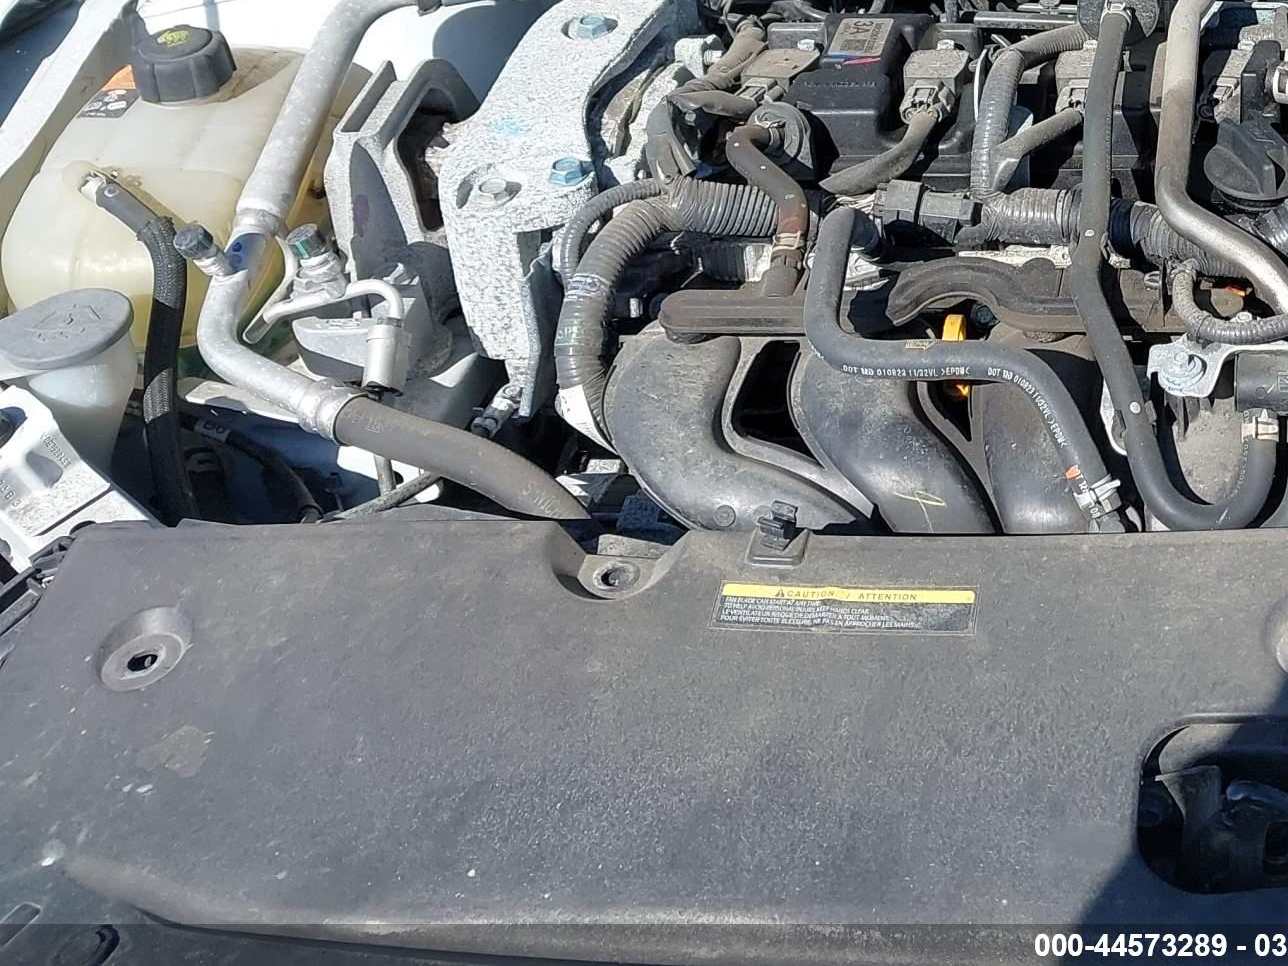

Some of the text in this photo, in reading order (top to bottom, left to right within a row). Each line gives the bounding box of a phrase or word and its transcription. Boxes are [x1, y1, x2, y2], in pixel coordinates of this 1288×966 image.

[849, 19, 874, 35] 3A
[987, 366, 1001, 377] DOT
[858, 592, 917, 600] ATTENTION
